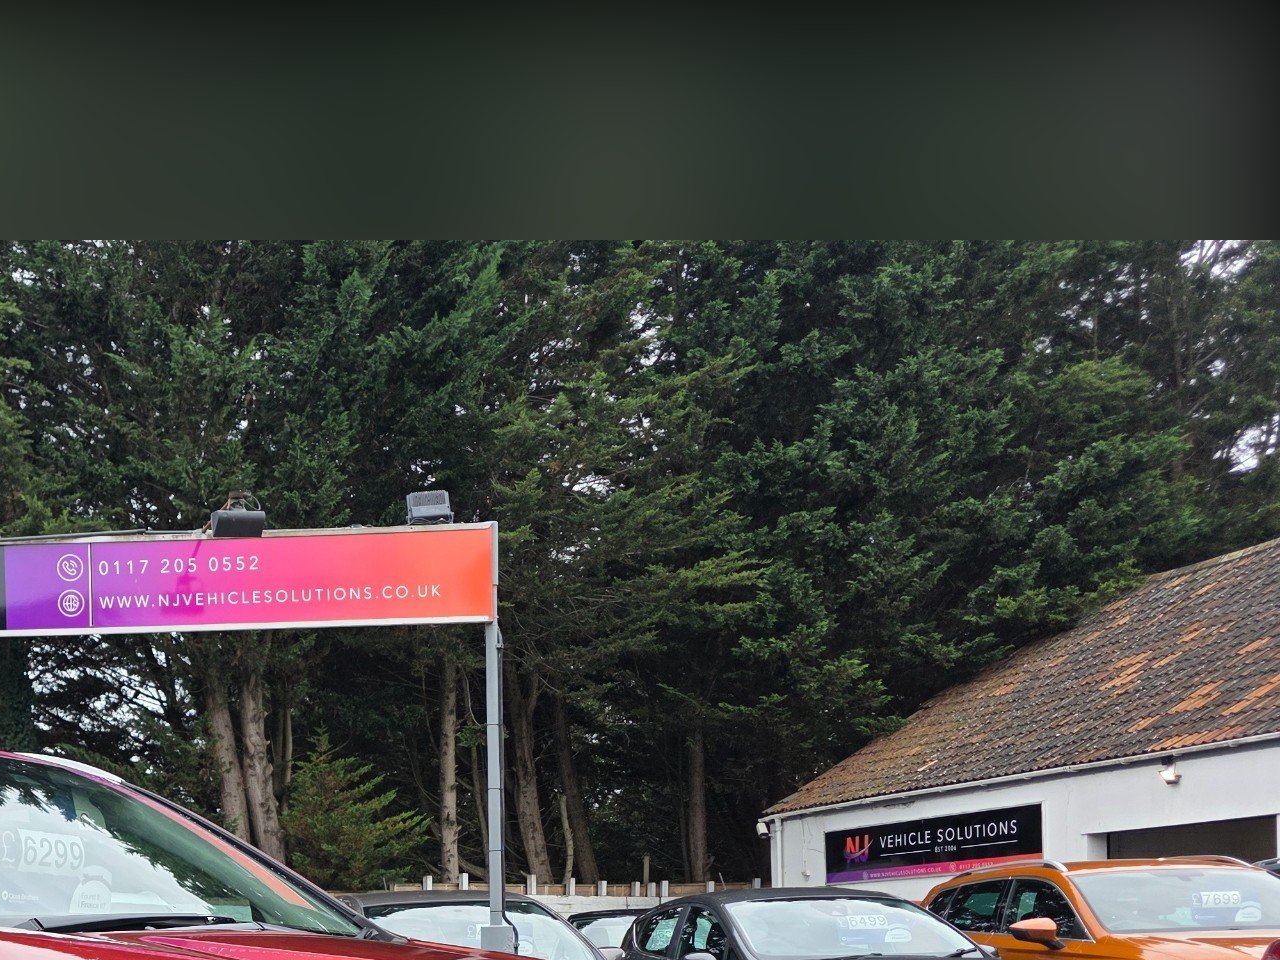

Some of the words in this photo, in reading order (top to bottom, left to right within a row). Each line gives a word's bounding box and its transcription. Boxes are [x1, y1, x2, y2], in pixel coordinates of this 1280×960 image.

[98, 559, 150, 576] 0117
[160, 557, 198, 574] 205
[208, 555, 260, 572] 0552
[99, 584, 442, 609] WWW.NJVEHICLESOLUTIONS.CO.UK
[879, 830, 931, 849] VEHICLE
[937, 819, 1018, 842] SOLUTIONS
[1, 830, 84, 871] £6299
